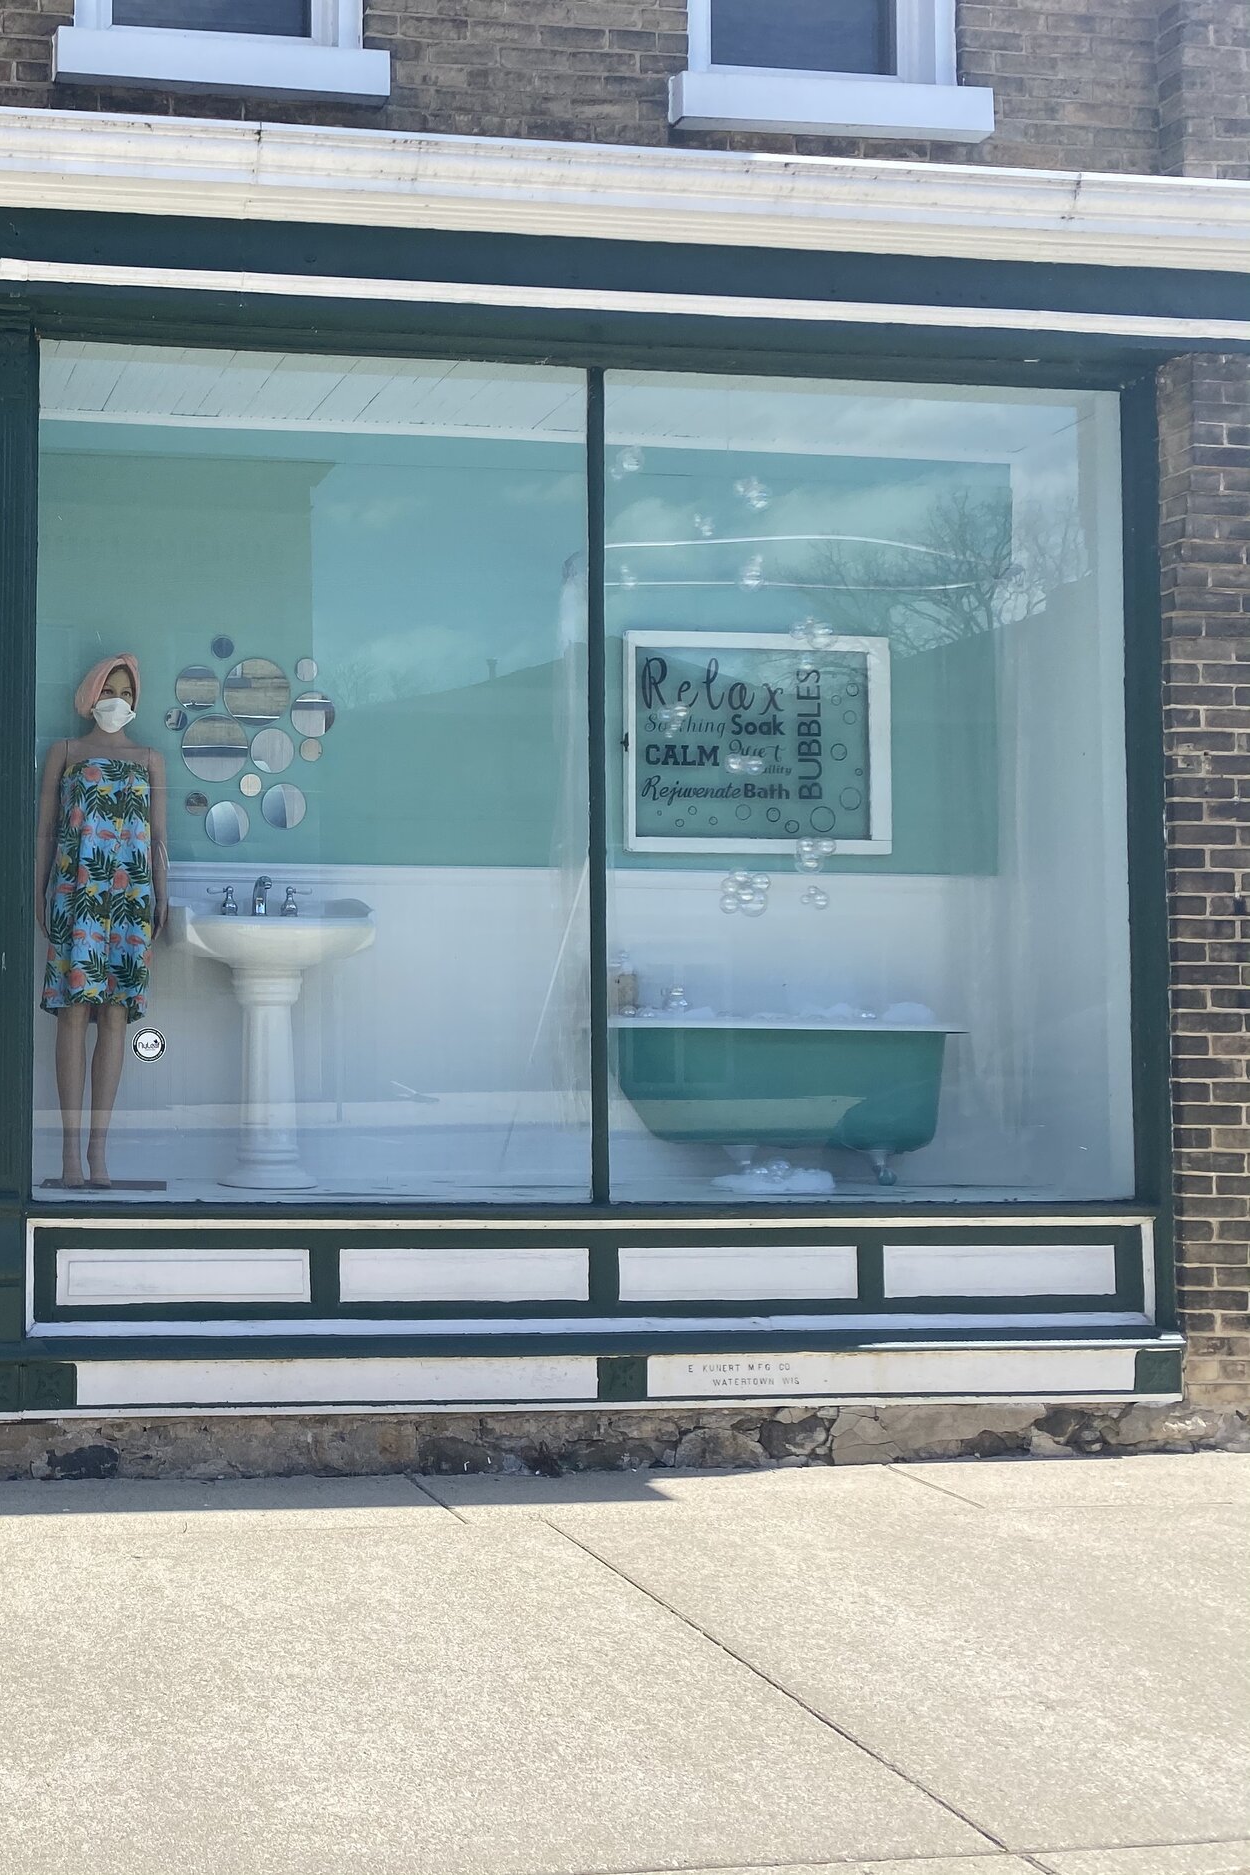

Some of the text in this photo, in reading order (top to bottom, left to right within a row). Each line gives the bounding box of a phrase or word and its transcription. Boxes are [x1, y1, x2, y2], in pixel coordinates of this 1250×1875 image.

[641, 656, 784, 715] Relax
[731, 714, 786, 736] Soak
[796, 668, 823, 800] BUBBLES
[645, 739, 786, 767] CALM Quiet
[641, 775, 790, 806] Rejuvenate Bath
[688, 1362, 791, 1373] E KUNERT MFG CO
[712, 1377, 775, 1387] WATERTOWN
